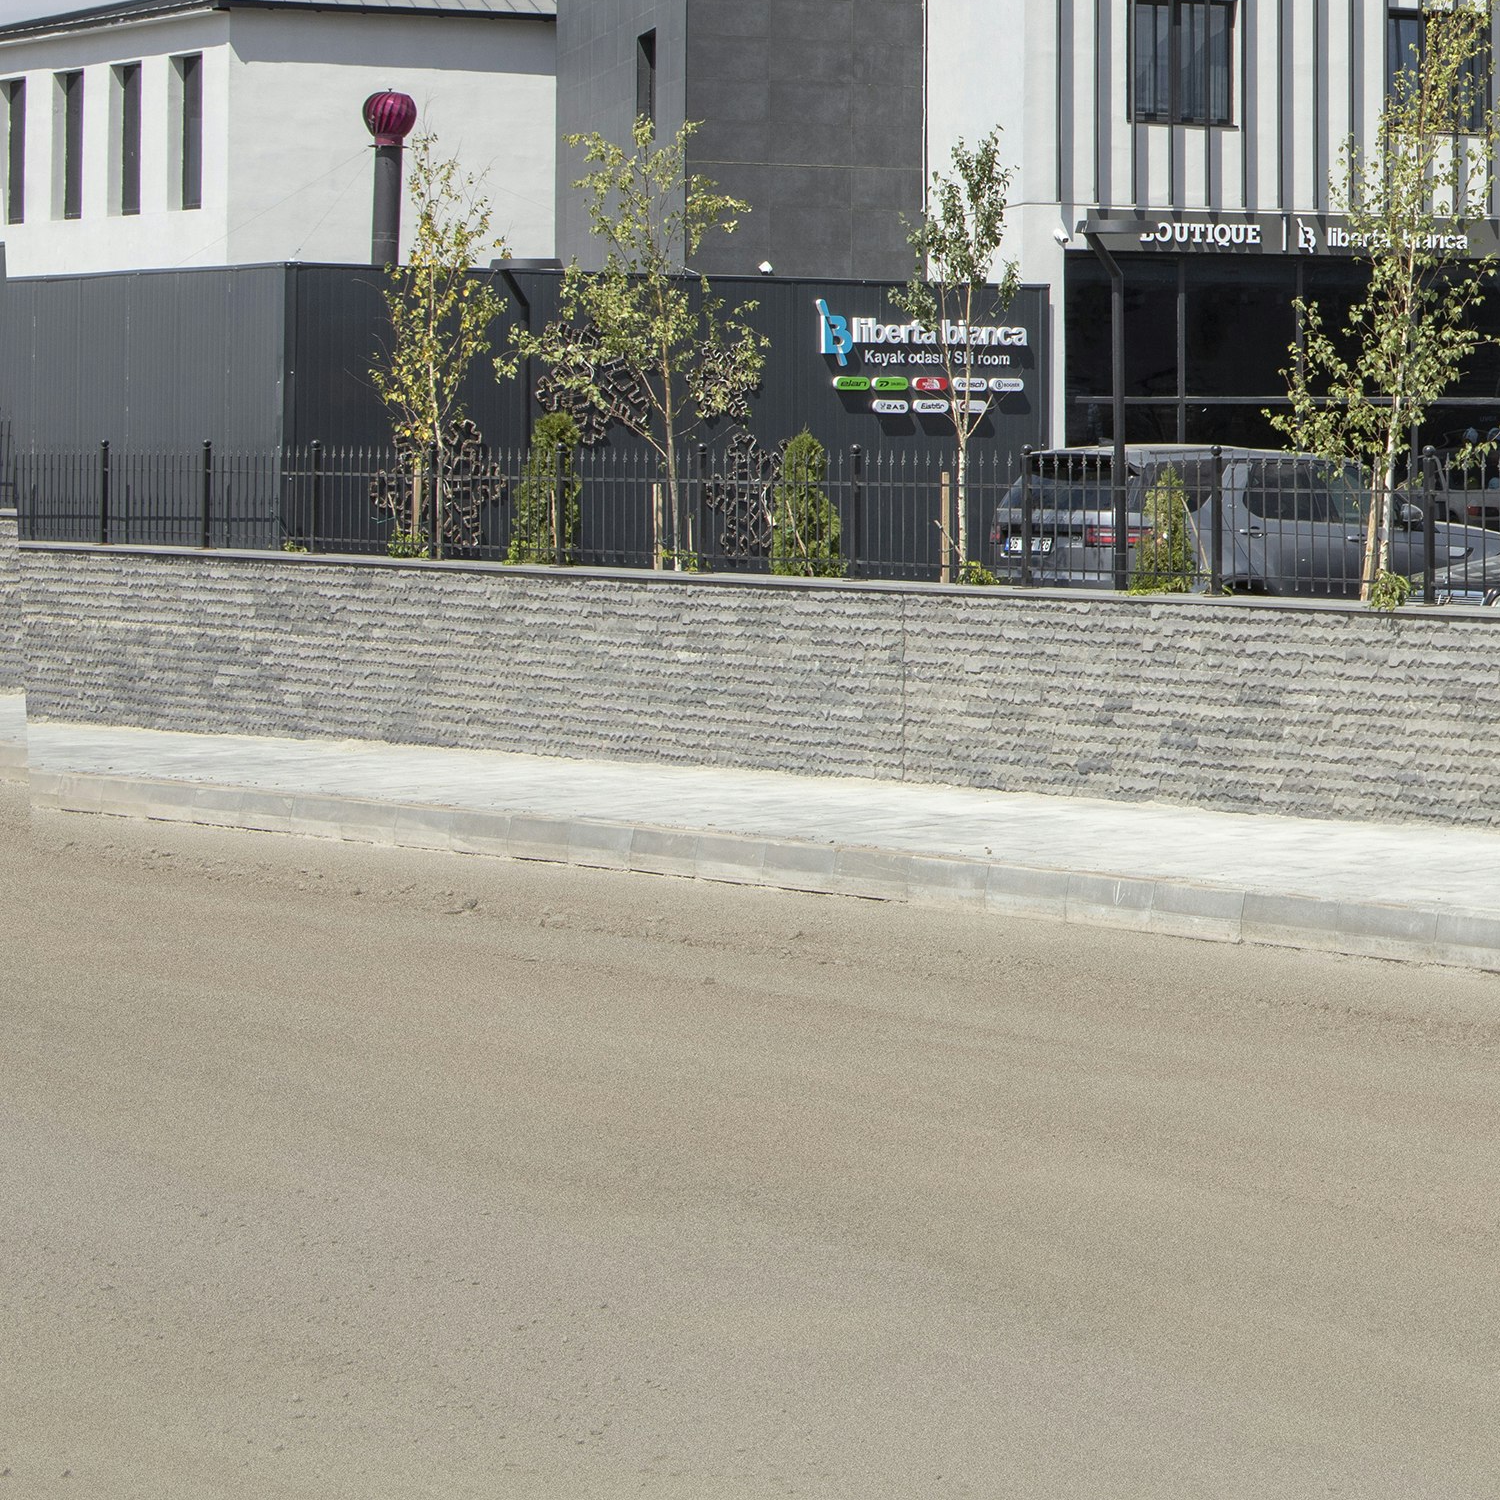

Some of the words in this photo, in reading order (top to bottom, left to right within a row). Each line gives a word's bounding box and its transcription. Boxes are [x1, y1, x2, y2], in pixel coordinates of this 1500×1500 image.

[942, 320, 1028, 346] bianca
[864, 349, 905, 367] Kayak
[978, 354, 1011, 366] room
[840, 379, 867, 388] elan
[957, 380, 985, 388] resch
